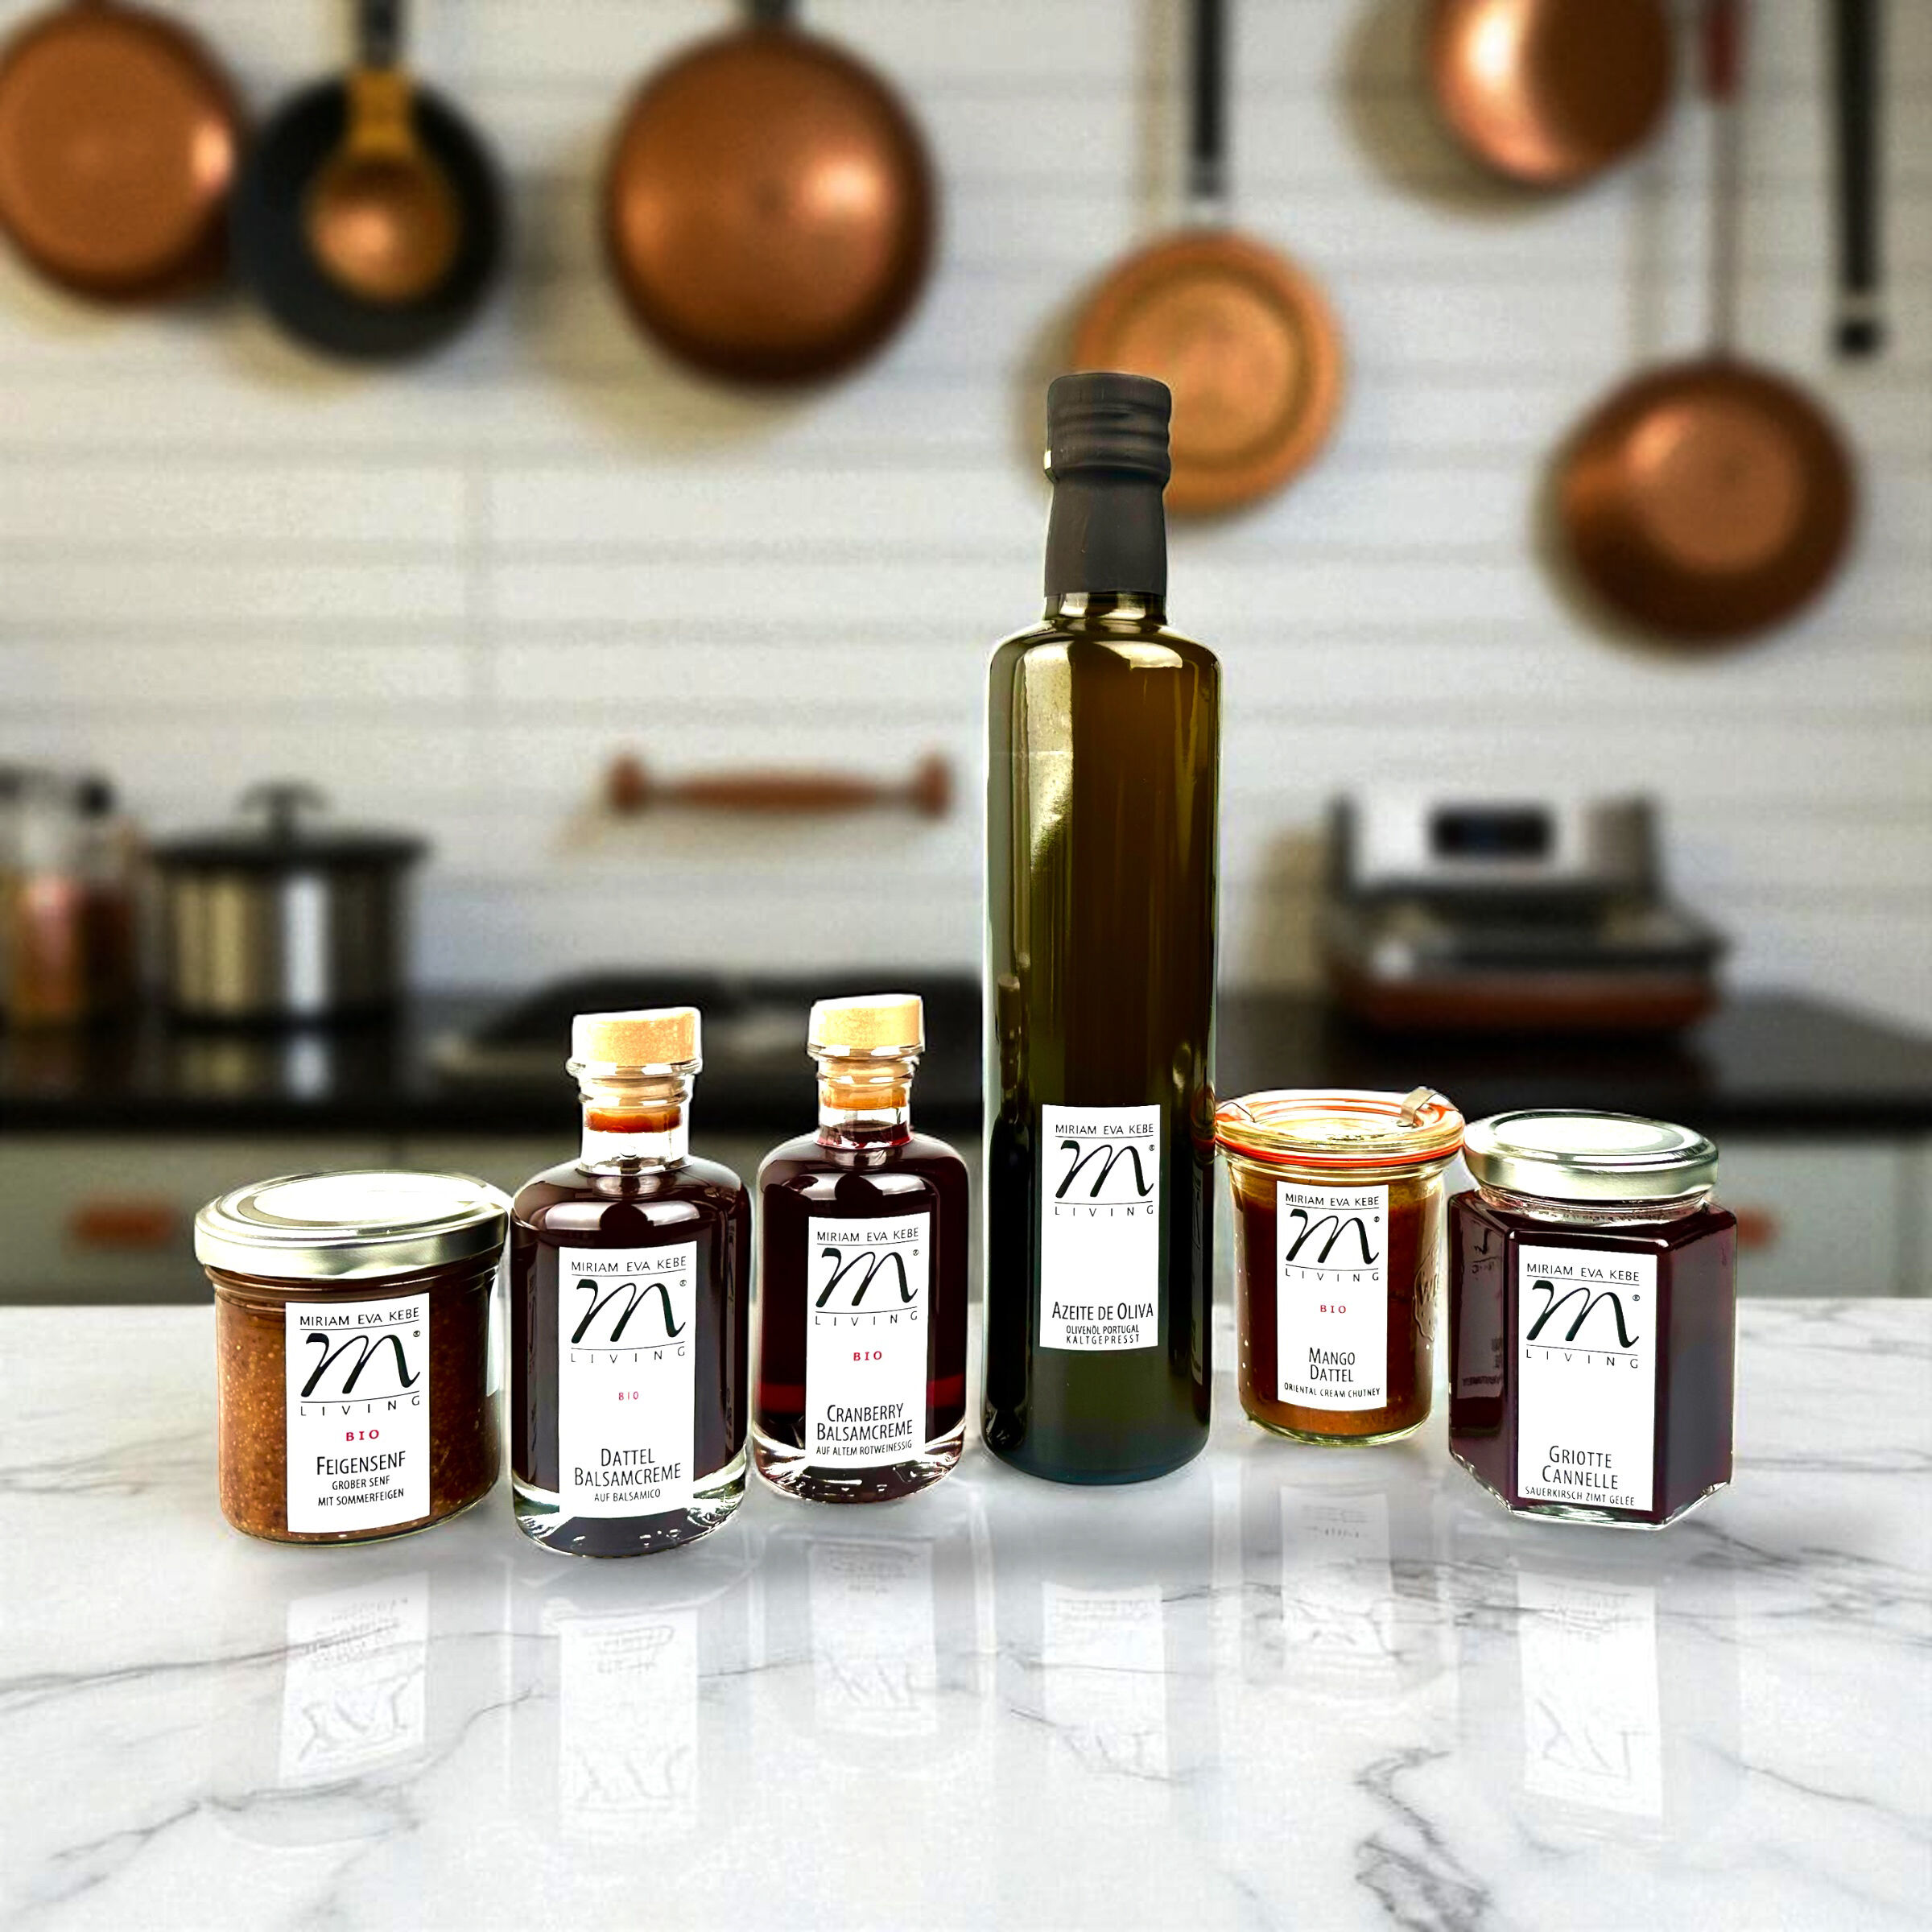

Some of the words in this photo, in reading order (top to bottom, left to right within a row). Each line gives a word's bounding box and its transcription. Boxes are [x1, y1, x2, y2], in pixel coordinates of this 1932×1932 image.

[1055, 1124, 1096, 1134] MIRIAM
[1104, 1126, 1124, 1134] EVA
[1129, 1124, 1154, 1133] KEBE
[1286, 1193, 1324, 1206] MIRIAM
[1330, 1198, 1350, 1206] EVA
[1355, 1196, 1379, 1206] KEBE
[1055, 1205, 1153, 1216] LIVING
[817, 1231, 860, 1242] MIRIAM
[867, 1232, 888, 1241] EVA
[894, 1228, 919, 1240] KEBE
[572, 1261, 618, 1273] MIRIAM
[627, 1261, 650, 1271] EVA
[657, 1256, 687, 1269] KEBE
[1527, 1263, 1573, 1276] MIRIAM
[1581, 1268, 1603, 1278] EVA
[1610, 1270, 1639, 1281] KEBE
[1286, 1269, 1378, 1282] LIVING
[299, 1315, 349, 1326] MIRIAM
[357, 1314, 382, 1325] EVA
[389, 1307, 419, 1321] KEBE
[1052, 1302, 1094, 1320] AZEITE
[1098, 1306, 1113, 1320] DE
[1117, 1302, 1154, 1319] OLIVA
[1320, 1305, 1346, 1314] BIO
[815, 1311, 917, 1326] LIVING
[1067, 1325, 1100, 1334] OLIVENÖL
[1103, 1325, 1139, 1334] PORTUGAL
[1067, 1334, 1140, 1344] KALTGEPRESST
[571, 1346, 685, 1364] LIVING
[853, 1352, 882, 1360] BIO
[1309, 1347, 1356, 1365] MANGO
[1526, 1349, 1638, 1368] LIVING
[1311, 1364, 1353, 1381] DATTEL
[618, 1391, 639, 1401] BIO
[1285, 1382, 1317, 1396] ORIENTAL
[1320, 1388, 1345, 1397] CREAM
[1348, 1388, 1380, 1397] CHUTNEY
[301, 1396, 420, 1416] LIVING
[827, 1403, 904, 1422] CRANBERRY
[346, 1430, 379, 1441] BIO
[817, 1419, 912, 1441] BALSAMCREME
[816, 1446, 830, 1455] AUF
[832, 1447, 857, 1455] ALTEM
[860, 1440, 912, 1455] ROTWEINESSIG
[317, 1451, 406, 1475] FEIGENSENF
[601, 1448, 655, 1467] DATTEL
[1550, 1446, 1612, 1468] GRIOTTE
[332, 1479, 366, 1490] GROBER
[369, 1476, 390, 1487] SENF
[575, 1463, 681, 1487] BALSAMCREME
[1542, 1465, 1618, 1489] CANNELLE
[318, 1496, 334, 1506] MIT
[336, 1488, 404, 1505] SOMMERFEIGEN
[594, 1492, 610, 1501] AUF
[613, 1489, 661, 1501] BALSAMICO
[1525, 1486, 1583, 1501] SAUERKIRSCH
[1586, 1492, 1605, 1503] ZIMT
[1609, 1496, 1634, 1506] GELÉE
